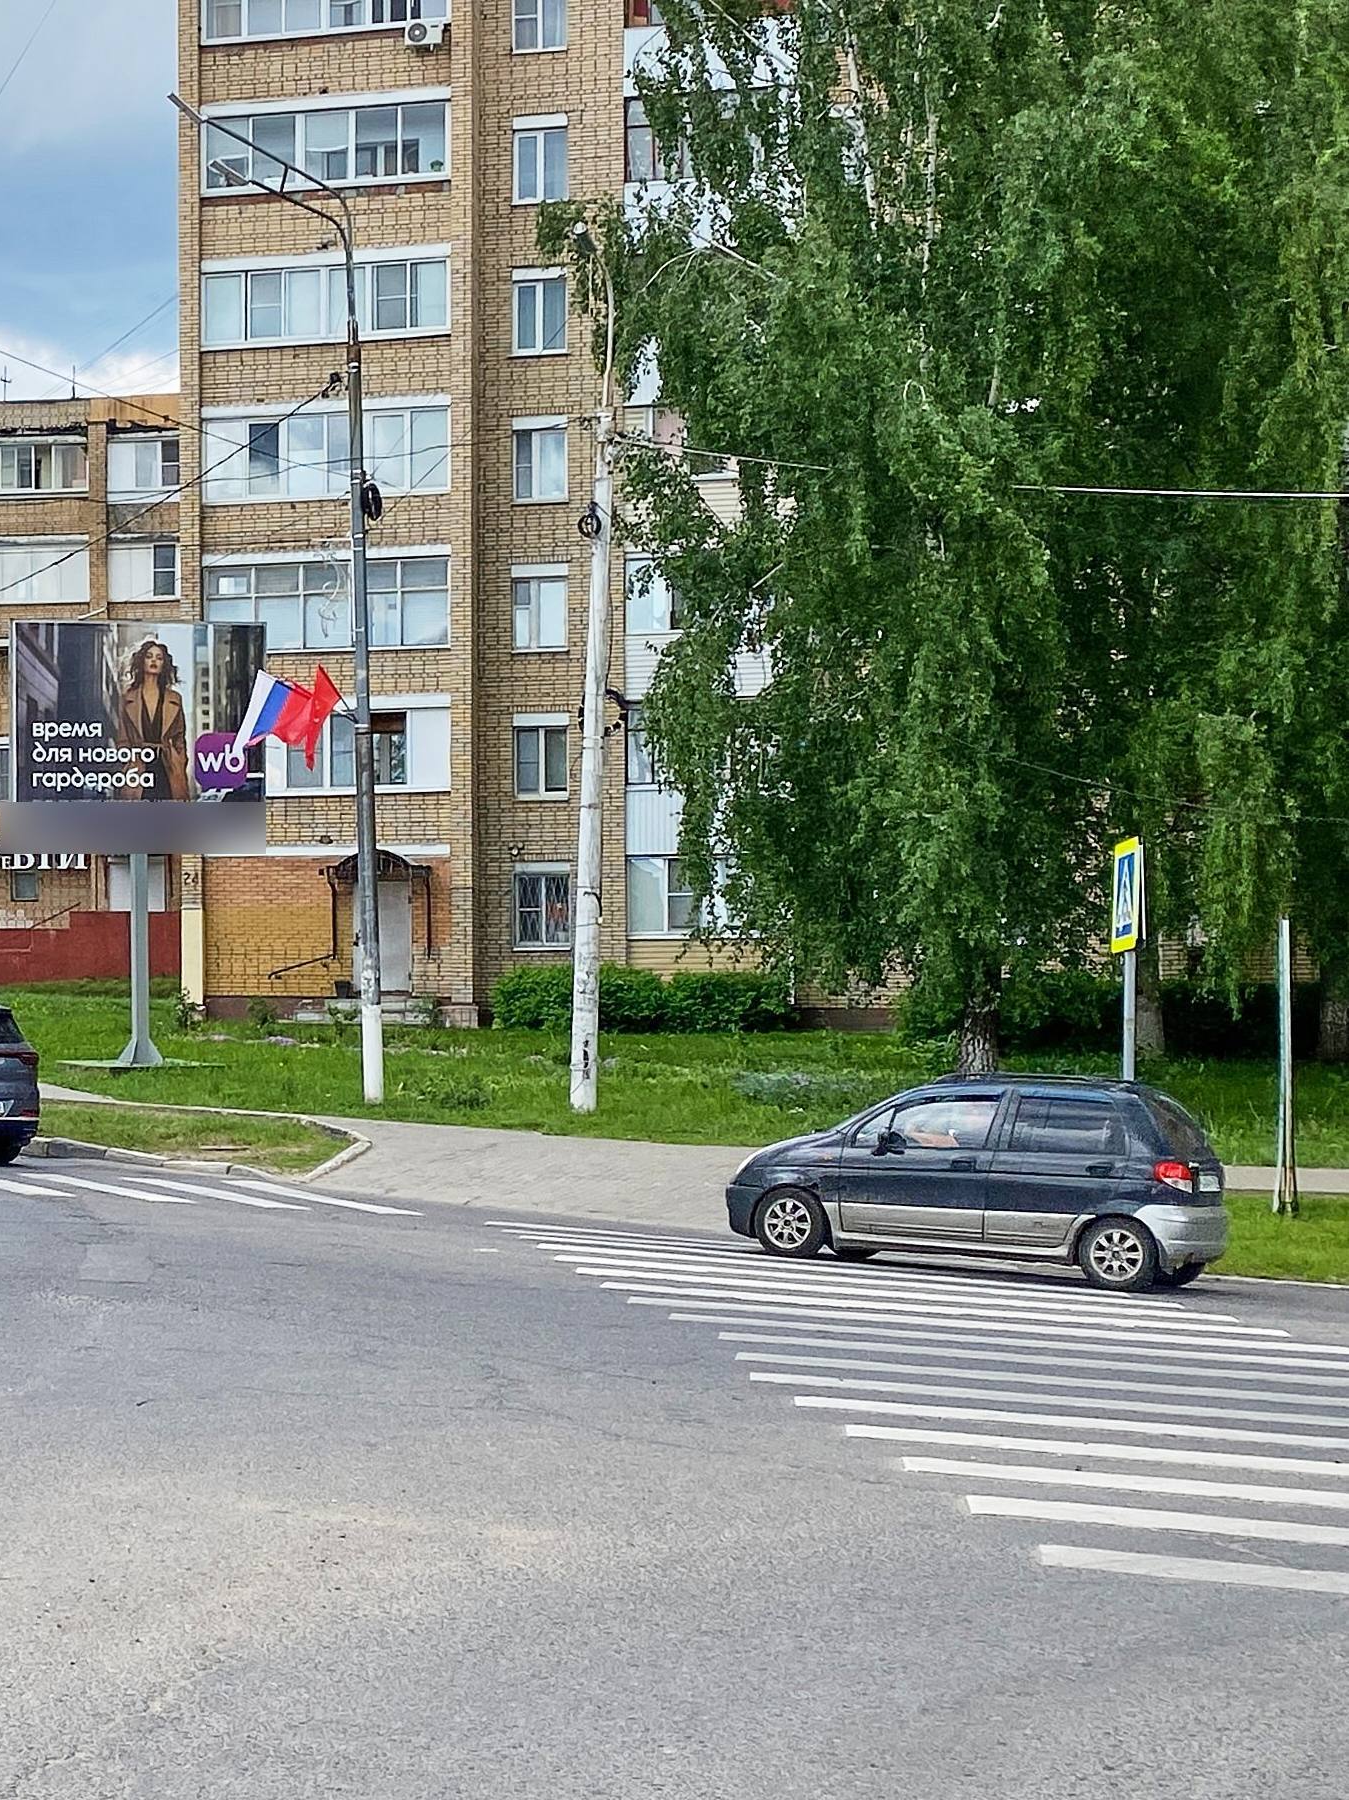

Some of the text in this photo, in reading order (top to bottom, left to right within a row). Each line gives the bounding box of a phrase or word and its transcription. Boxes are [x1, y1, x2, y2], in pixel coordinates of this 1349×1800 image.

[32, 722, 102, 741] время
[32, 742, 155, 763] для нового
[32, 767, 155, 791] гардероба
